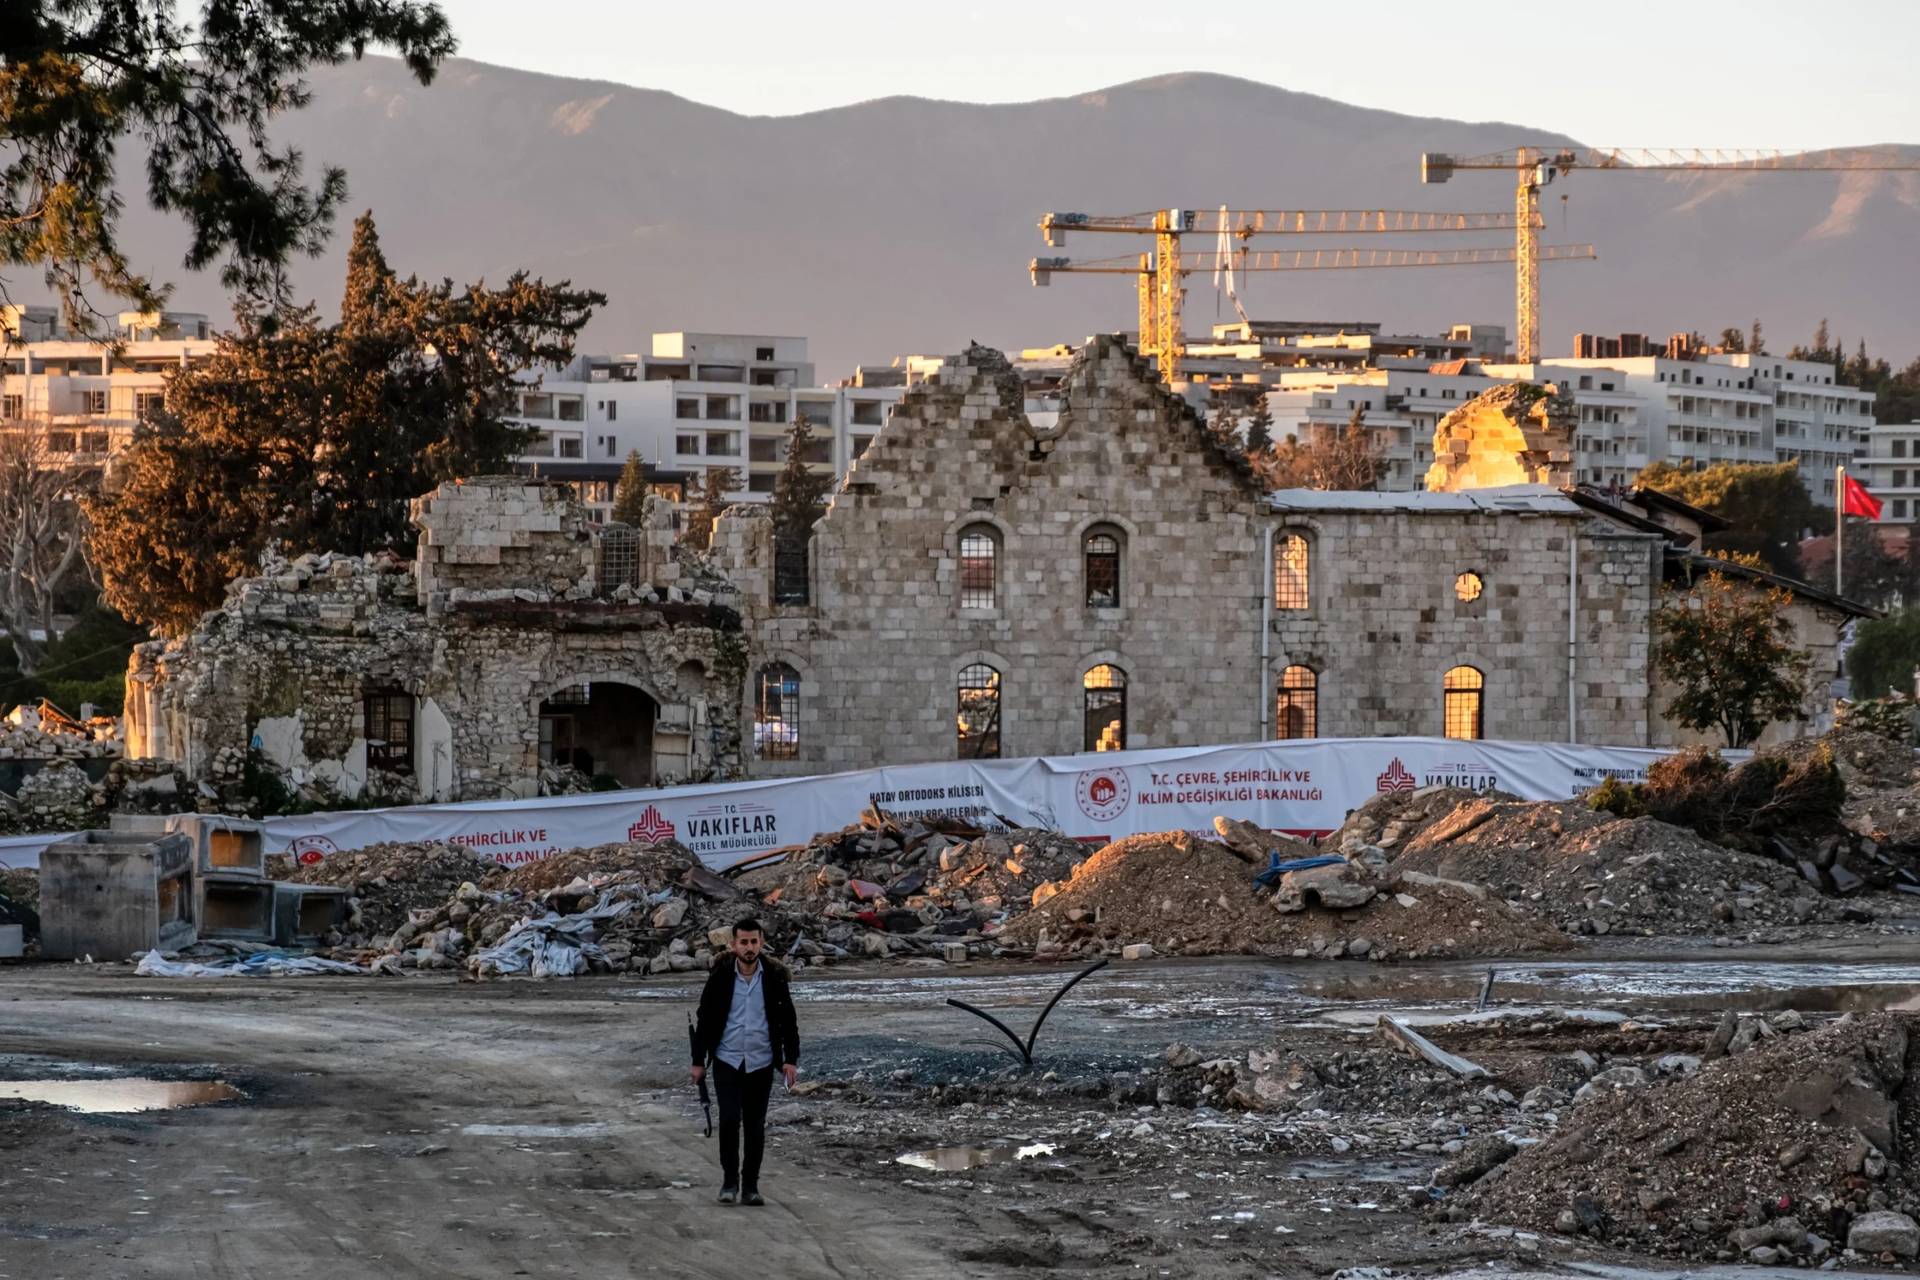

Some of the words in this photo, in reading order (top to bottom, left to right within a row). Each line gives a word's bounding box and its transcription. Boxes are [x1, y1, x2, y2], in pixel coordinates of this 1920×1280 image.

[1151, 774, 1173, 786] T.C.
[1176, 773, 1220, 787] ÇEVRE,
[1223, 768, 1292, 786] ŞEHİRCİLİK
[1295, 770, 1311, 783] VE
[1425, 775, 1497, 791] VAKIFLAR
[869, 791, 896, 803] HATAY
[898, 788, 945, 802] ORTODOKS
[948, 784, 984, 799] KİLİSESİ
[1138, 789, 1173, 805] İKLİM
[1177, 787, 1253, 805] DEĞİŞİKLİĞİ
[1256, 787, 1323, 801] BAKANLIĞI
[528, 829, 547, 842] VE
[688, 815, 776, 838] VAKIFLAR
[689, 840, 717, 852] GENEL
[721, 835, 777, 849] MÜDÜRLÜĞÜ
